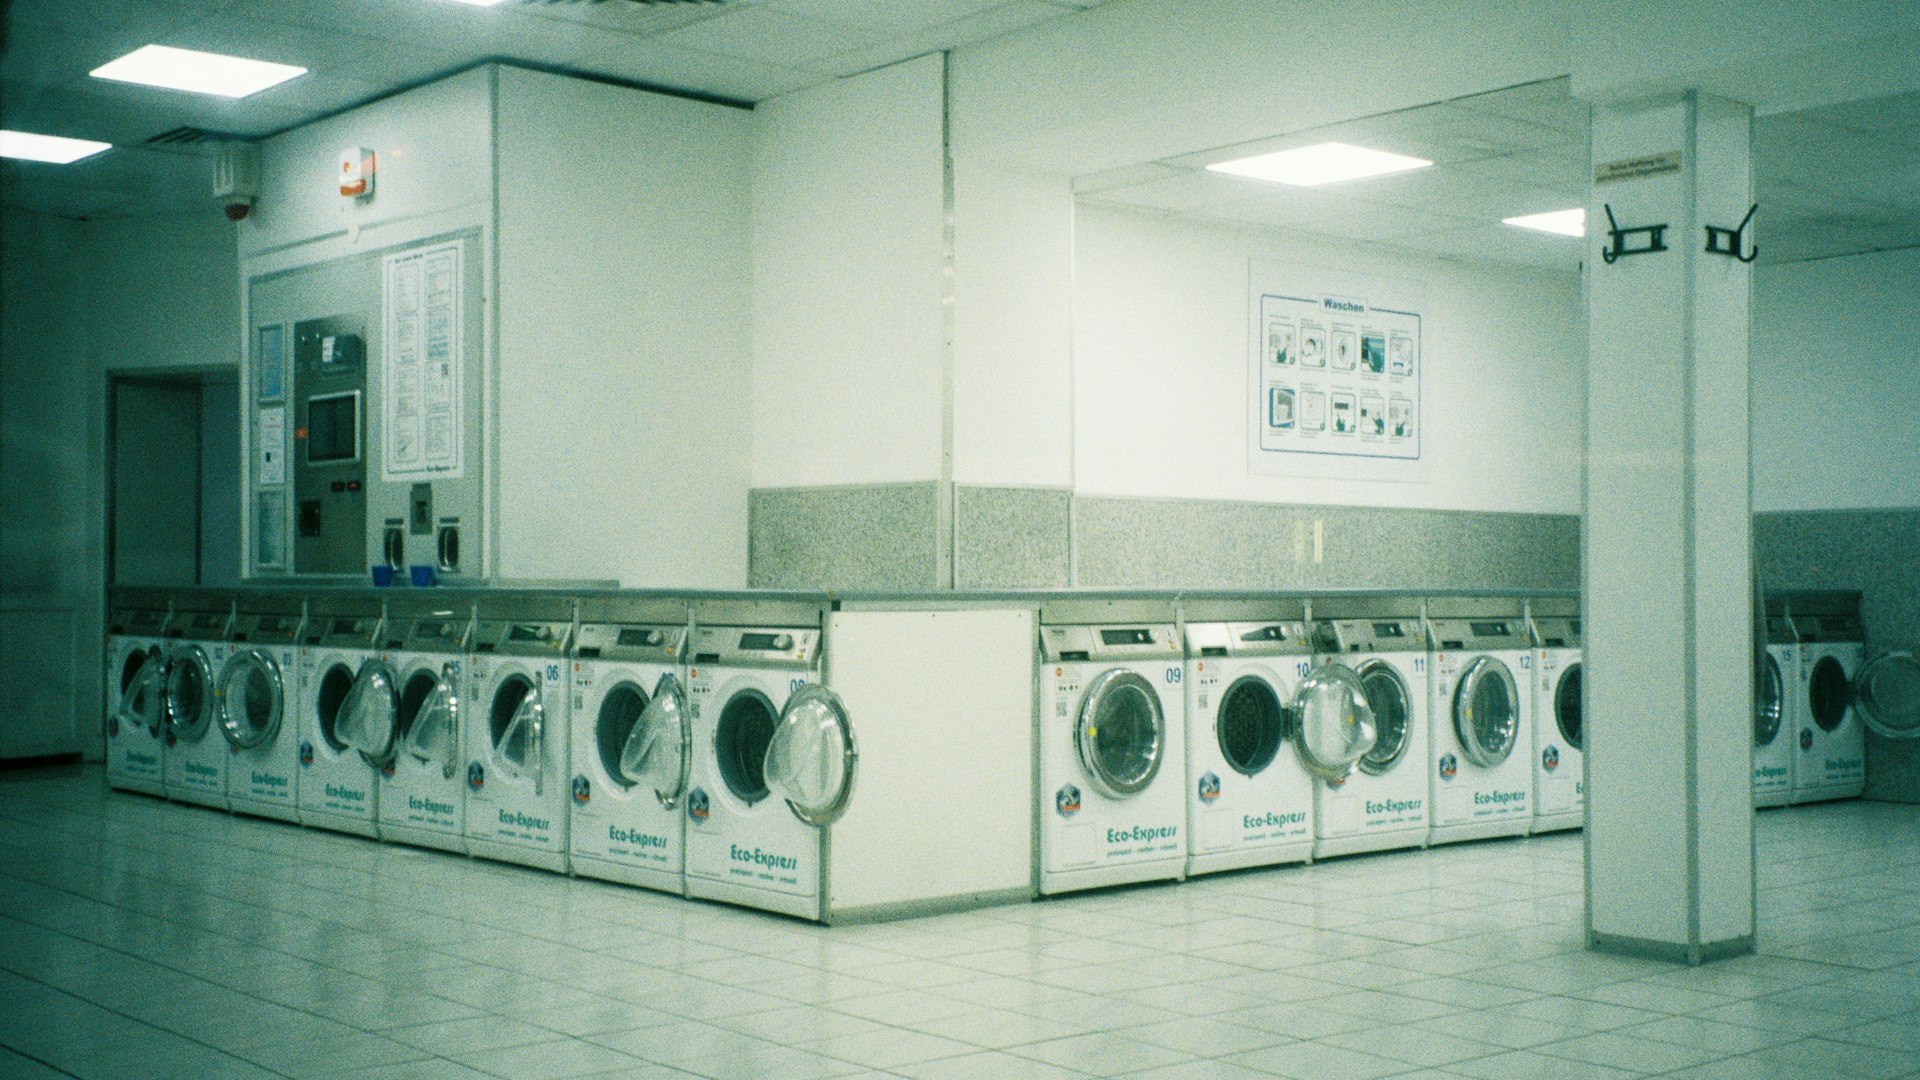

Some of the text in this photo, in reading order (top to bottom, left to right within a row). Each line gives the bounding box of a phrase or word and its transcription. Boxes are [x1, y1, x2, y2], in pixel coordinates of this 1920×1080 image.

[1324, 297, 1364, 312] Waschen
[1297, 662, 1308, 678] 10
[1414, 658, 1424, 672] 11
[1520, 655, 1530, 669] 12
[546, 664, 558, 680] 06
[1166, 667, 1180, 683] 09
[409, 796, 454, 815] Eco-Express
[1474, 790, 1525, 805] Eco-Express
[1366, 799, 1421, 814] Eco-Express
[499, 808, 549, 830] Eco-Express
[1243, 812, 1306, 828] Eco-Express
[609, 824, 667, 848] Eco-Express
[1107, 826, 1177, 843] Eco-Express
[730, 844, 797, 870] Eco-Express
